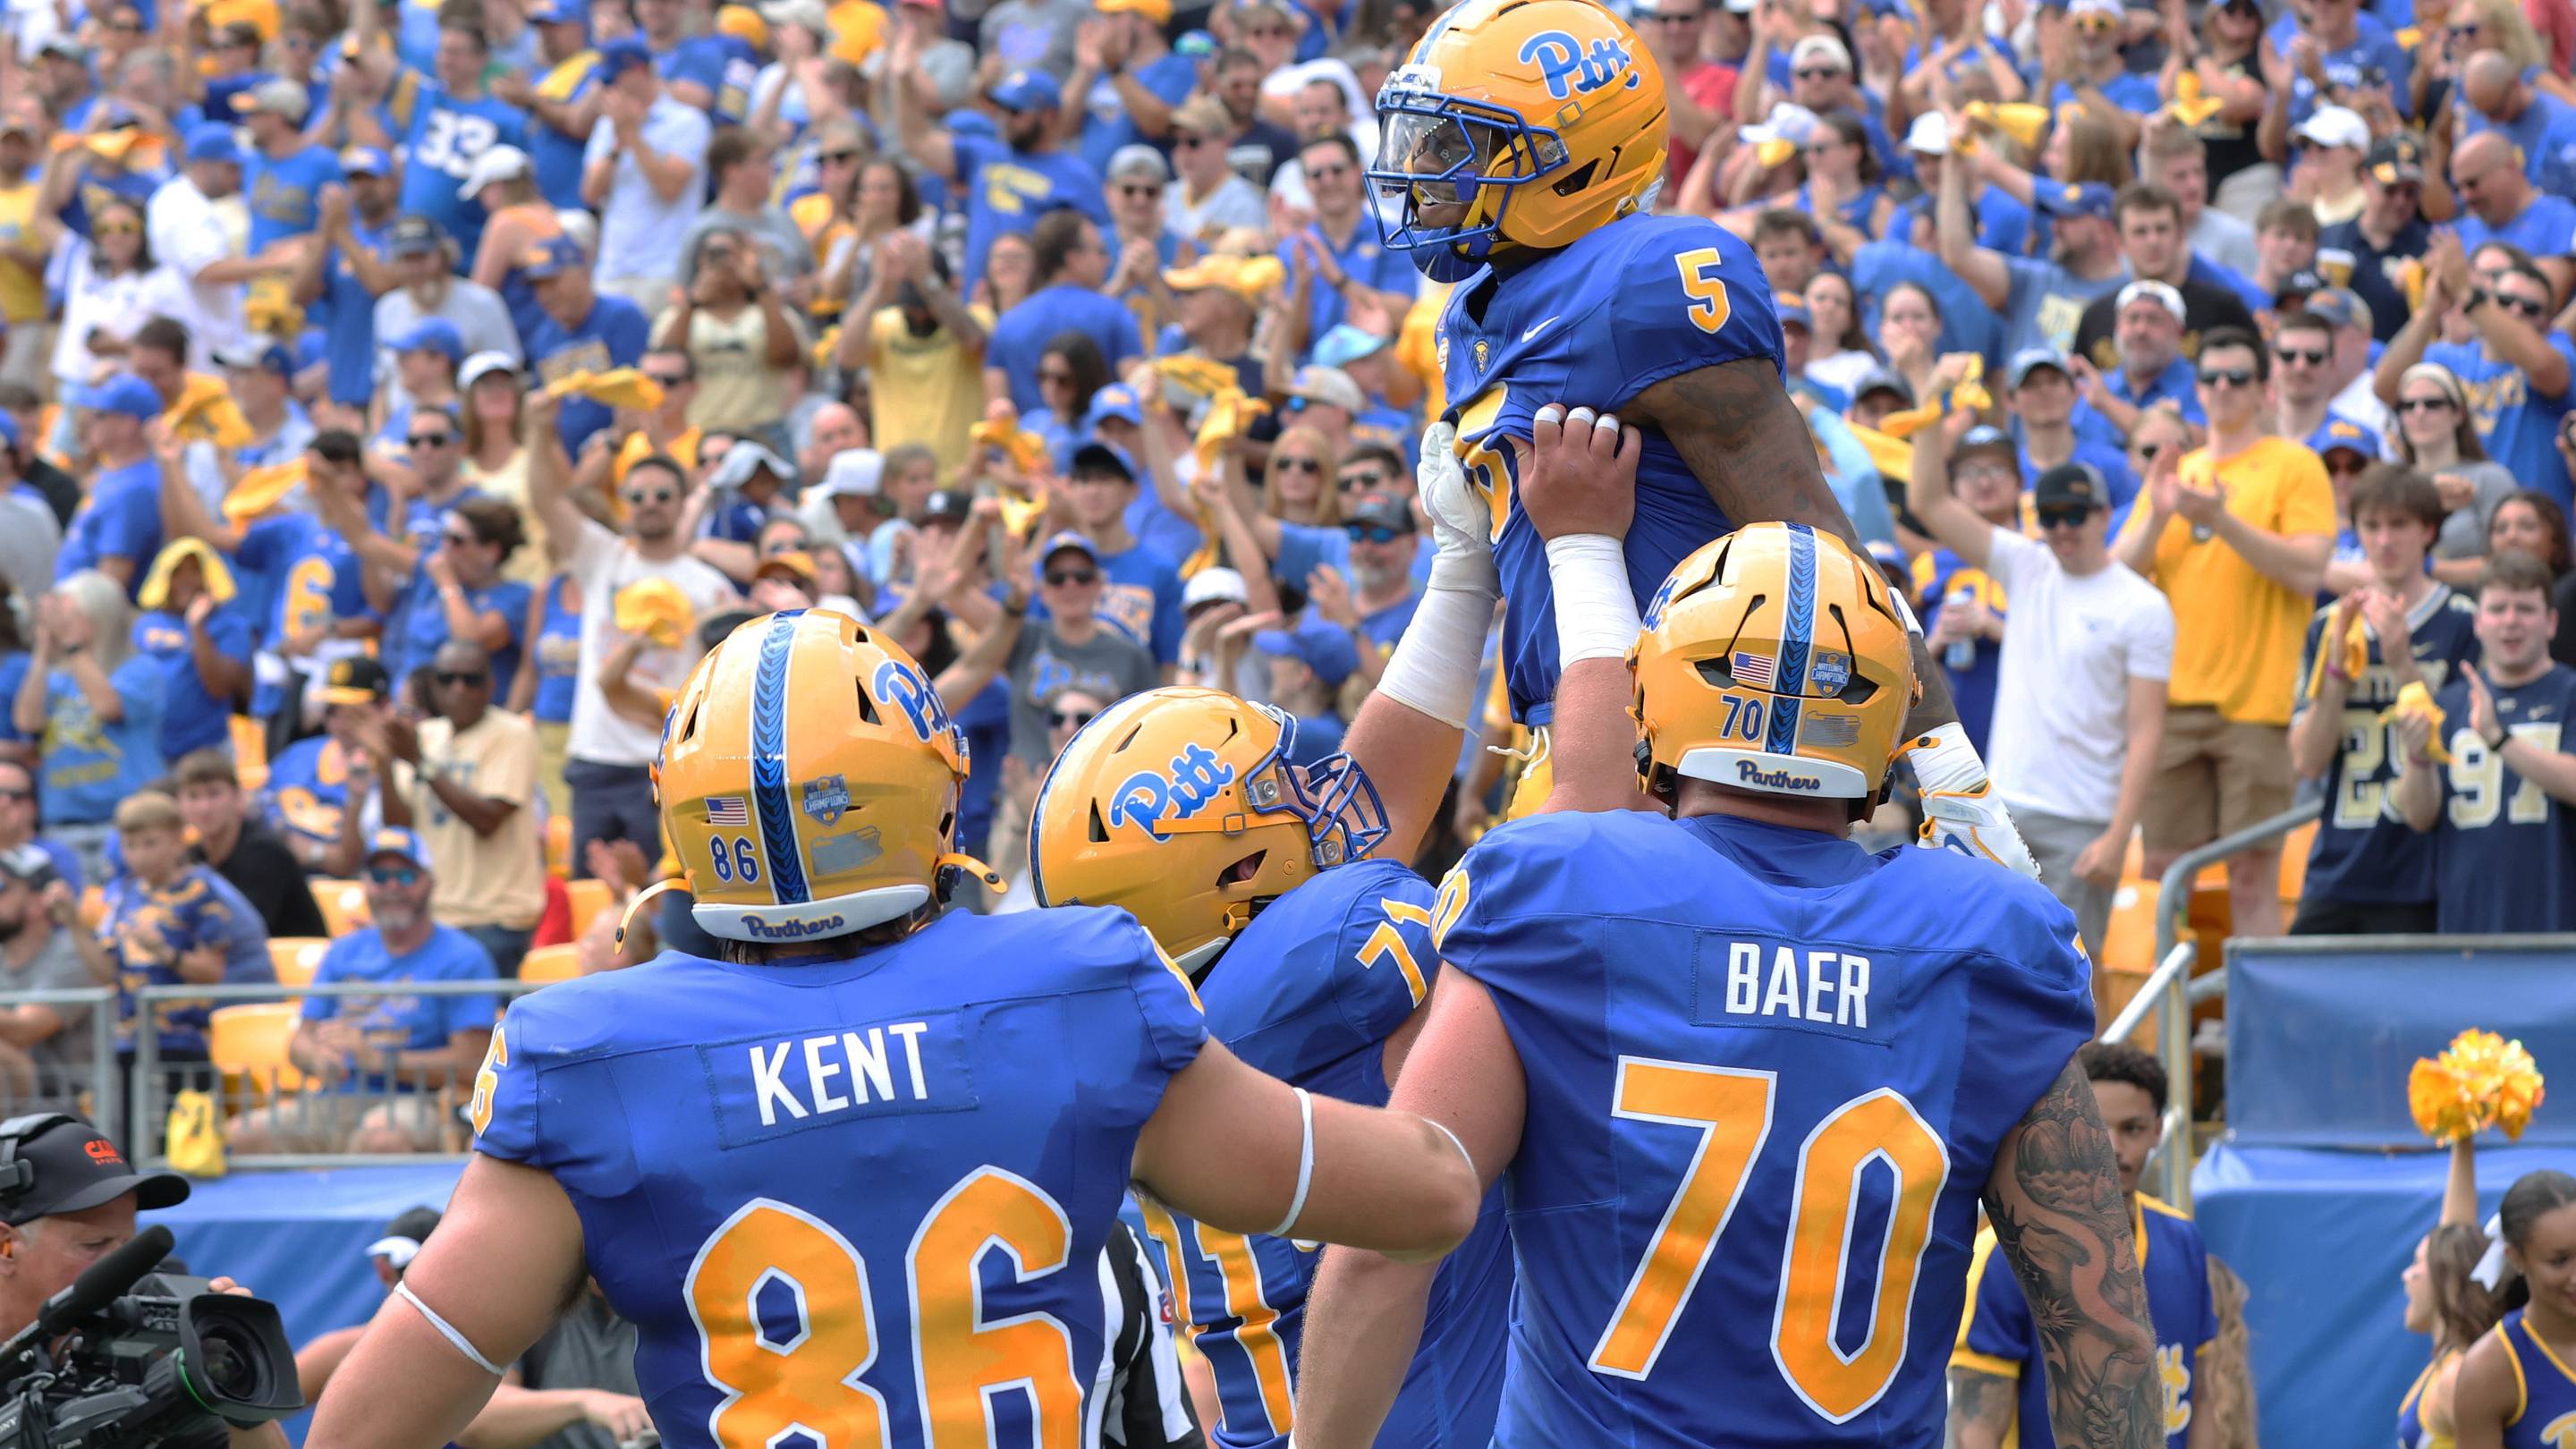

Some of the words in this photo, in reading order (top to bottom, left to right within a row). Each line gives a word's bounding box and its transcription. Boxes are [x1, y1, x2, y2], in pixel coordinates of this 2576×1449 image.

[1518, 30, 1640, 100] Pitt
[1674, 247, 1732, 335] 5
[1810, 667, 1848, 685] CHAMPIONS
[1720, 694, 1765, 742] 70
[803, 790, 849, 813] CHAMPIONS
[1108, 741, 1235, 844] Pitt
[1736, 759, 1821, 790] Panthers
[709, 835, 760, 884] 86
[741, 912, 845, 939] Panthers
[1354, 897, 1431, 1010] 71
[1724, 941, 1871, 1030] BAER
[749, 1021, 929, 1127] KENT
[1587, 1054, 1951, 1427] 70
[682, 1164, 1084, 1449] 86
